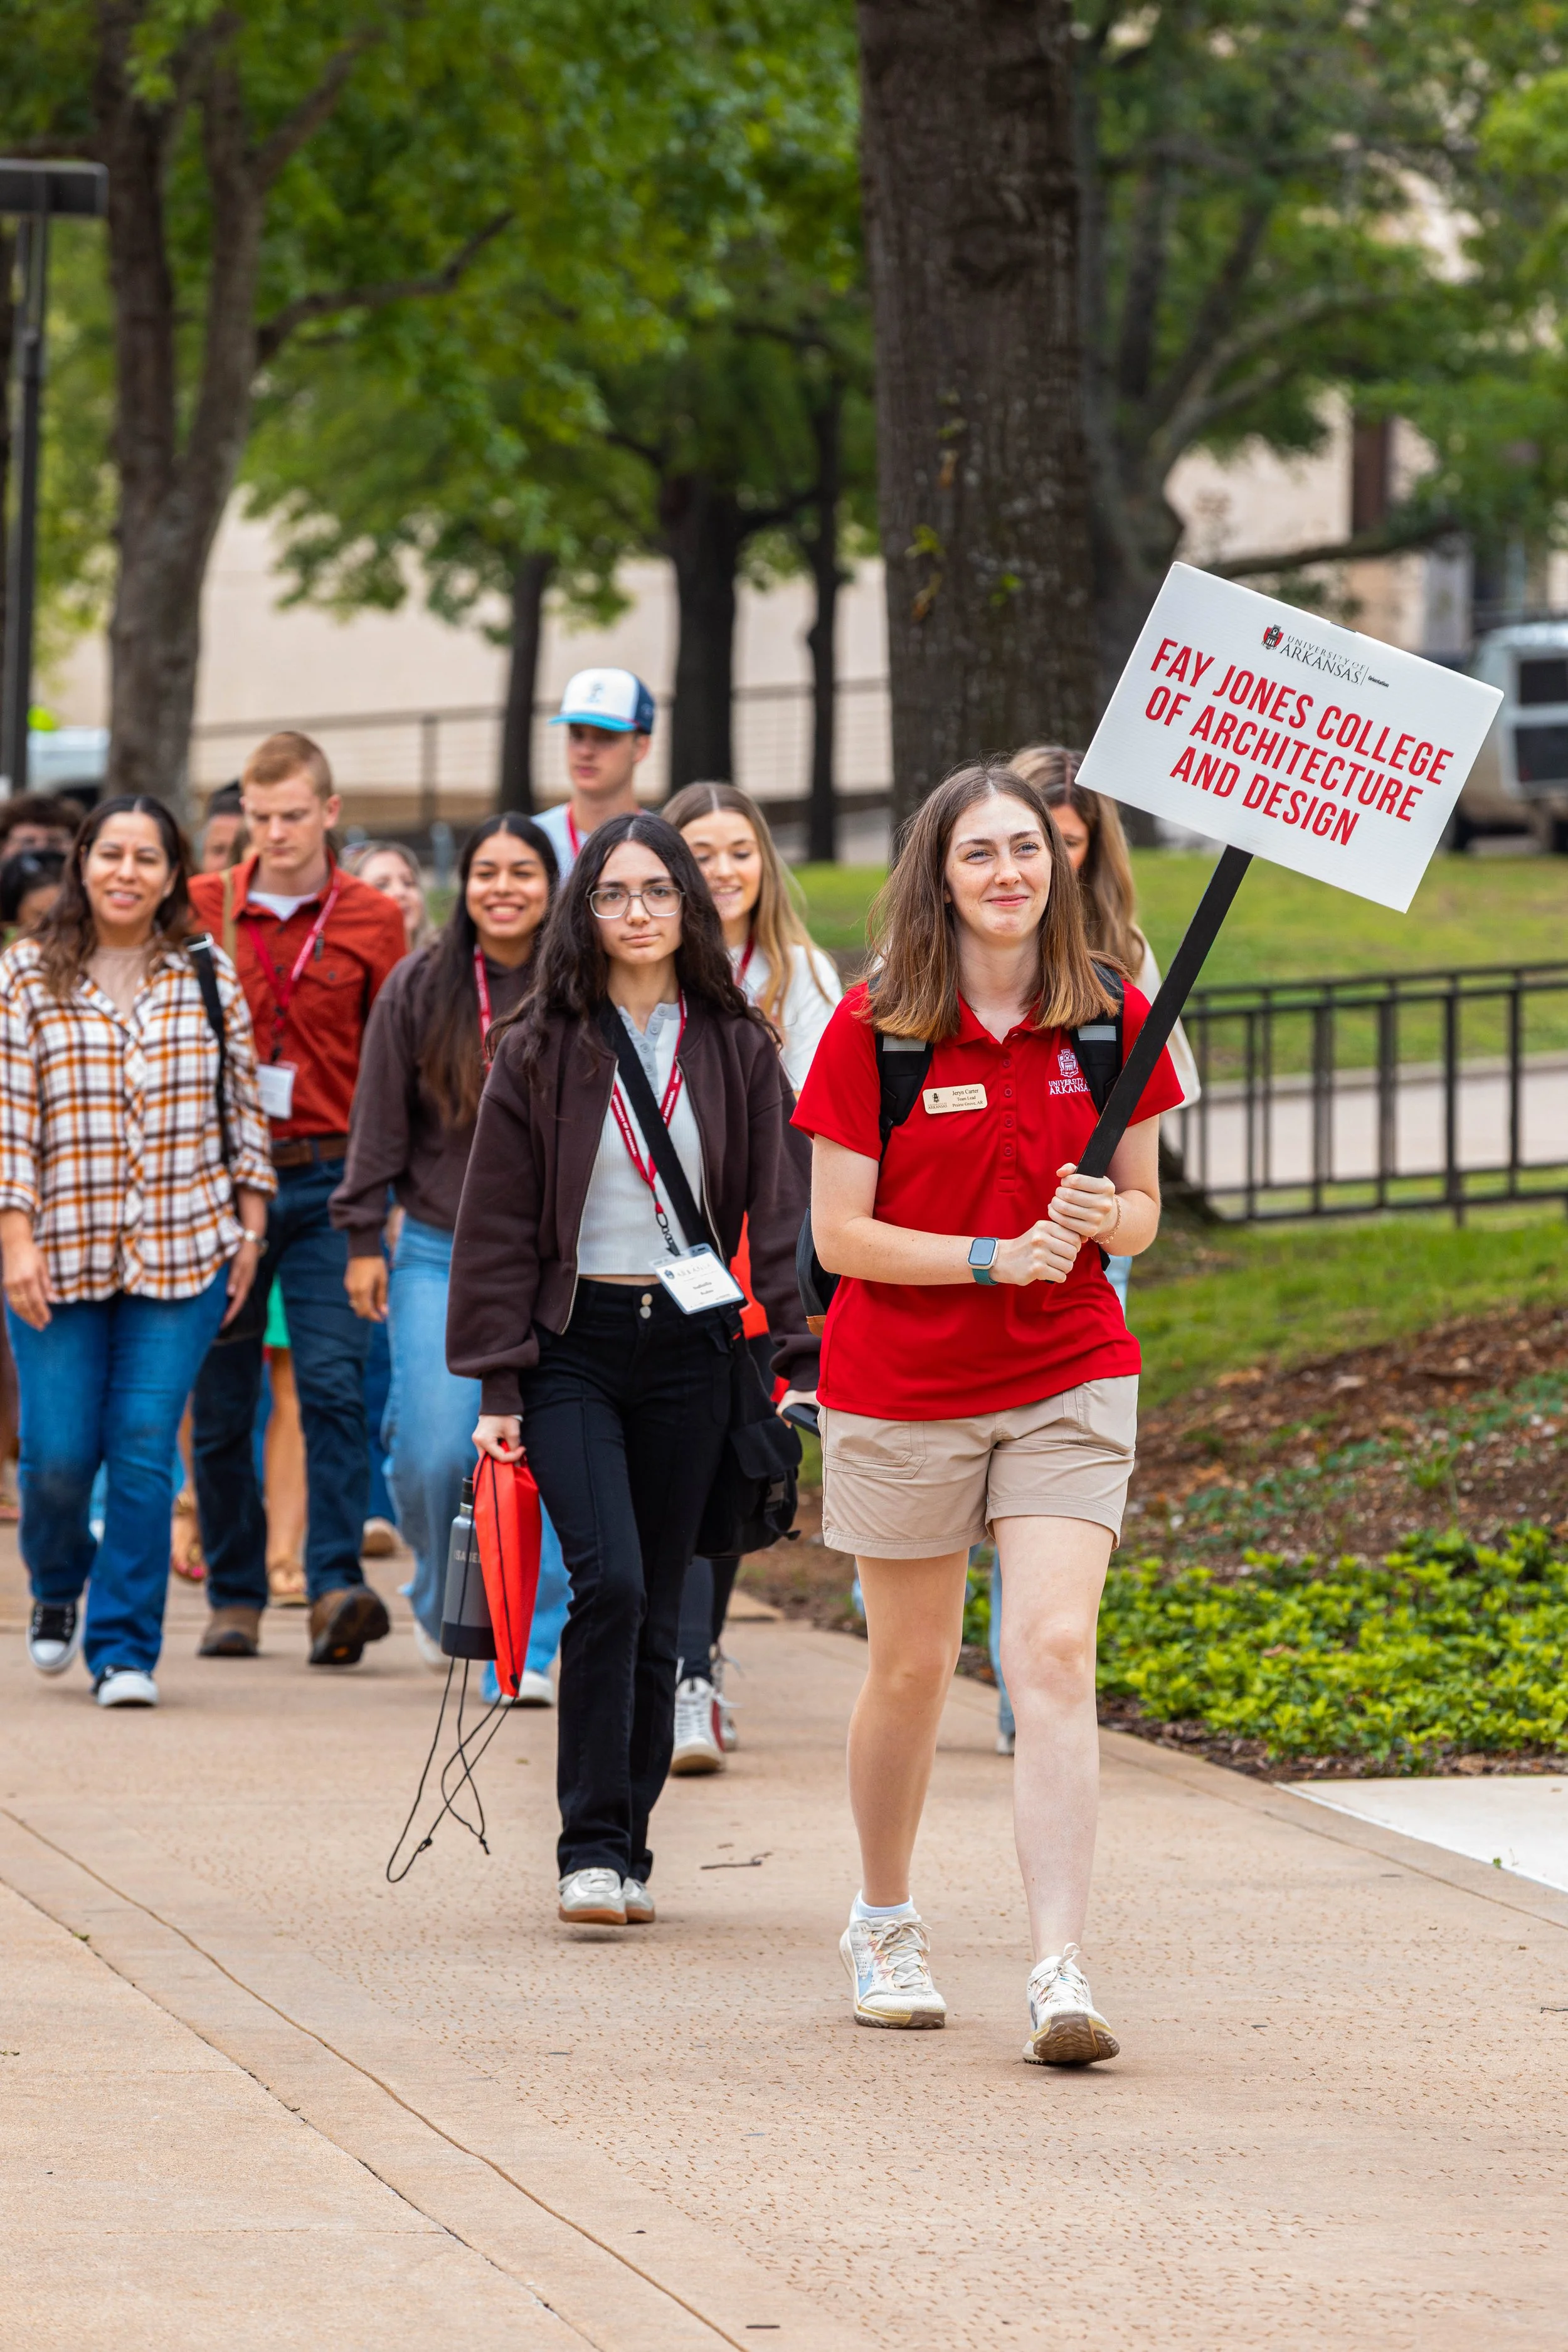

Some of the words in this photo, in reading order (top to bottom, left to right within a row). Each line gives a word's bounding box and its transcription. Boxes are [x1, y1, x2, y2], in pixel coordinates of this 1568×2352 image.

[1288, 635, 1350, 665] UNIVERSITY
[1352, 662, 1366, 671] OF
[1368, 675, 1390, 688] Orientation
[1150, 638, 1215, 682] FAY
[1213, 665, 1314, 729] JONES
[1316, 706, 1454, 785] COLLEGE
[1145, 686, 1192, 726] OF
[1189, 706, 1424, 822] ARCHITECTURE
[1170, 746, 1241, 798] AND
[1242, 774, 1360, 845] DESIGN
[1048, 1078, 1084, 1087] UNIVERSITY
[1049, 1083, 1091, 1095] ARKANSA
